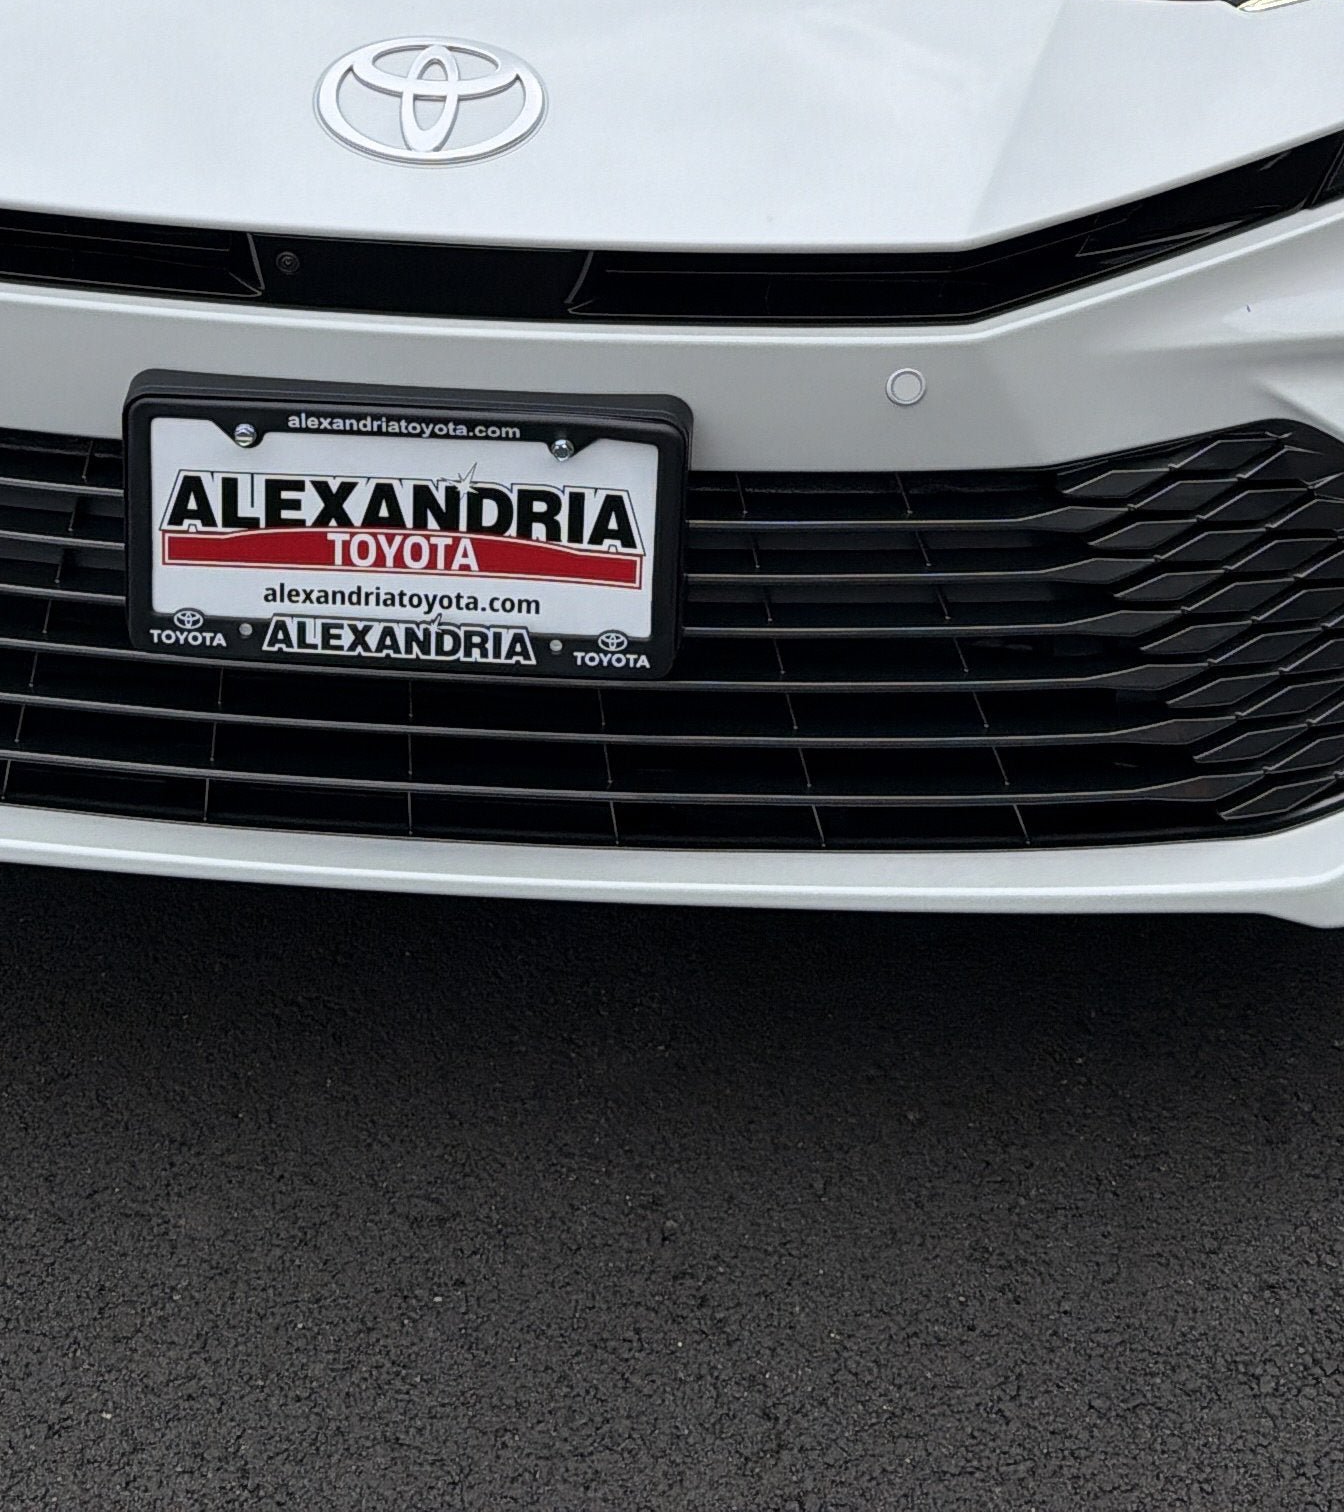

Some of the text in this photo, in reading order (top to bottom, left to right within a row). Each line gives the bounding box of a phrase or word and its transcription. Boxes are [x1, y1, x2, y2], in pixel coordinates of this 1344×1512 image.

[287, 412, 522, 439] alexandriatoyota.com
[165, 473, 638, 550] ALEXANDRIA
[326, 532, 480, 572] TOYOTA
[262, 582, 541, 616] alexandriatoyota.com
[149, 629, 228, 648] TOYOTA
[262, 615, 537, 665] ALEXANDRIA
[572, 651, 651, 669] TOYOTA
